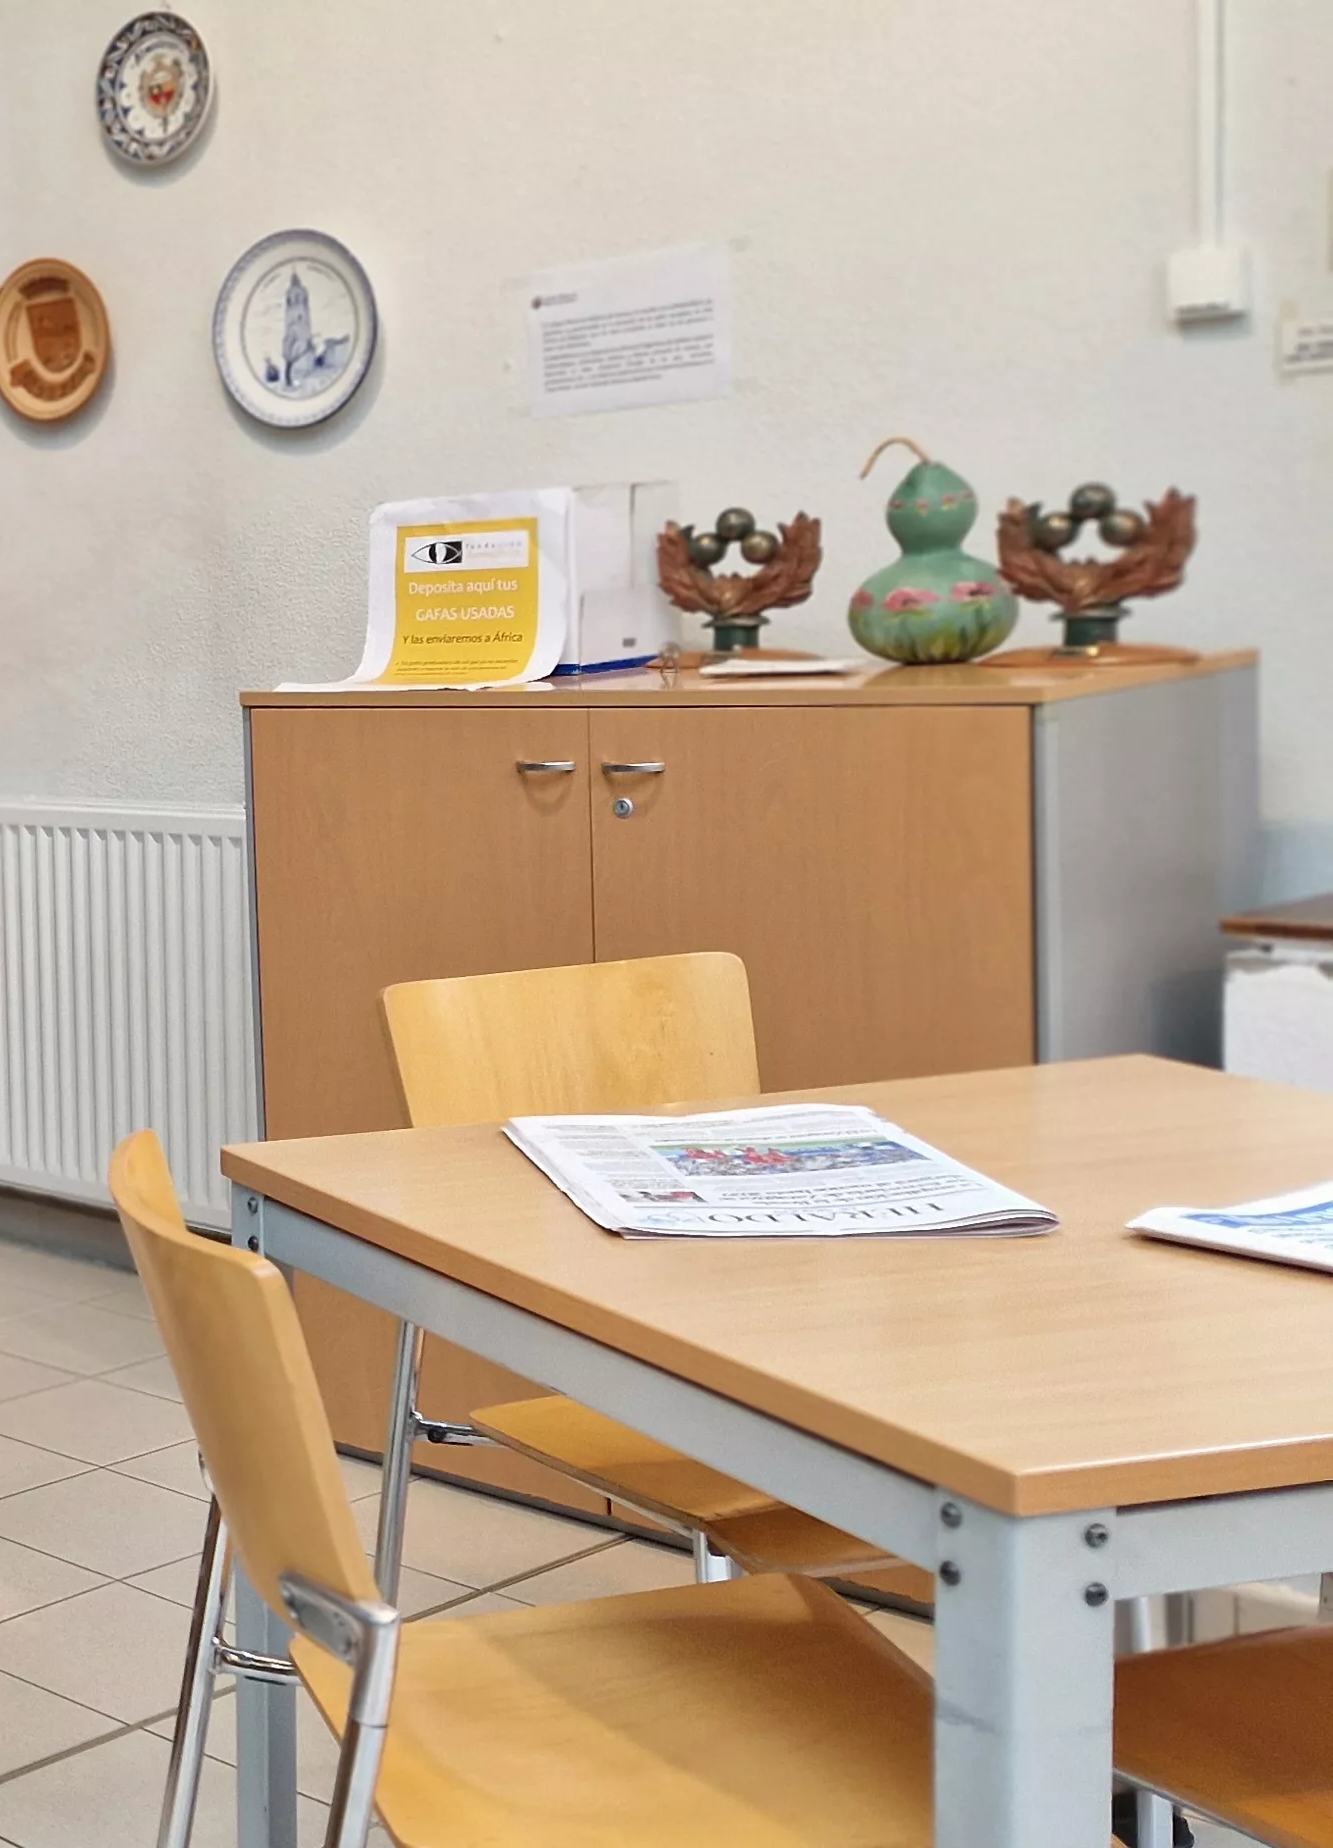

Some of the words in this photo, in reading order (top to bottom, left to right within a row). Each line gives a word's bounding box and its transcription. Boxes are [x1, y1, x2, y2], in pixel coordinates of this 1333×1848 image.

[409, 580, 464, 596] Deposita
[467, 578, 494, 595] aquí
[497, 579, 518, 592] tus
[416, 607, 458, 621] GAFAS
[461, 605, 515, 620] USADAS
[402, 635, 410, 645] Y
[411, 634, 424, 645] las
[426, 634, 483, 645] enviaremos
[484, 635, 491, 644] a
[492, 630, 523, 643] África
[709, 1202, 945, 1223] HERALDO
